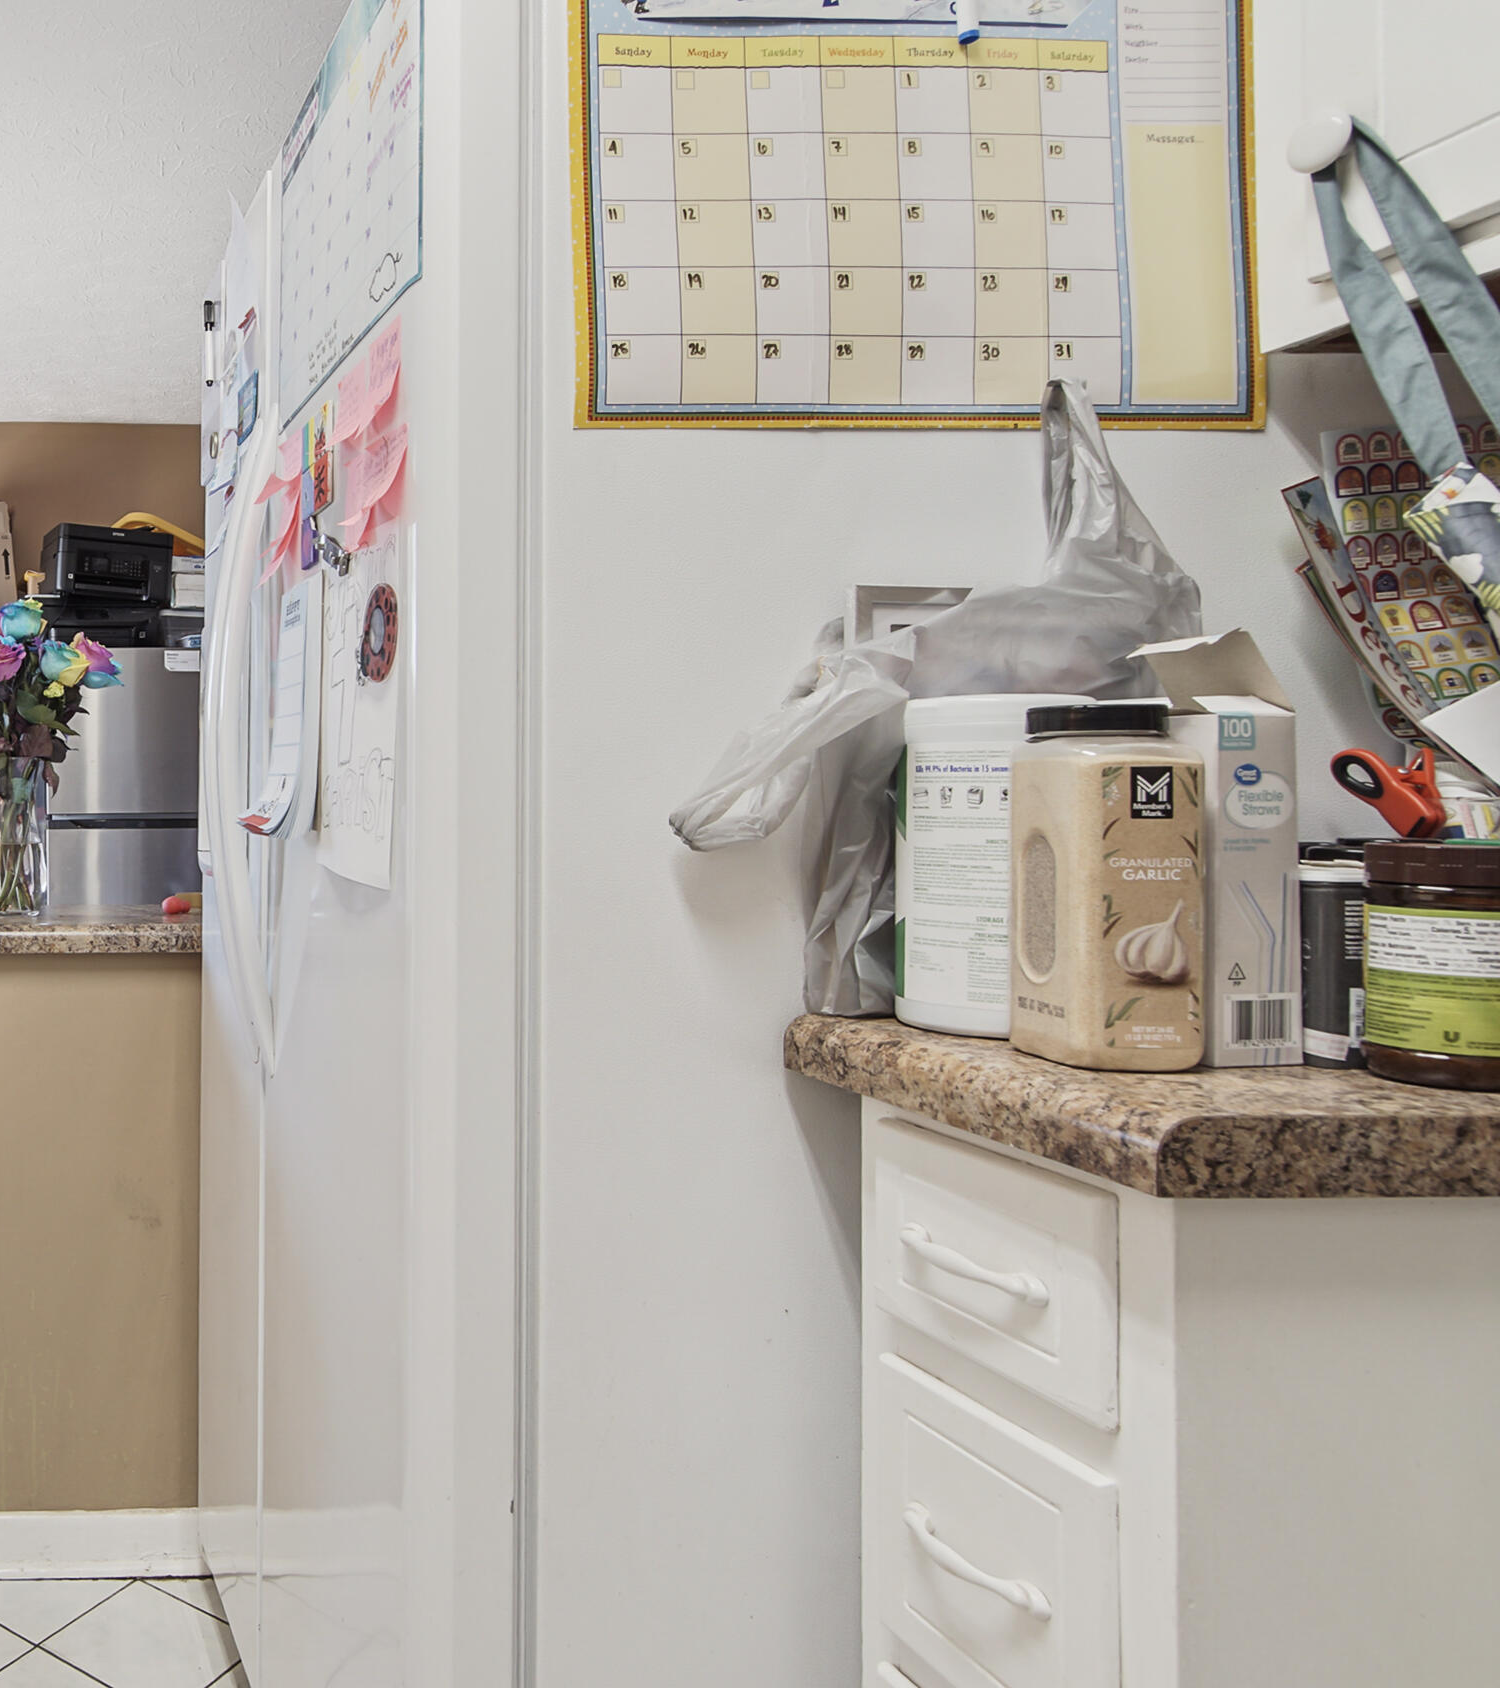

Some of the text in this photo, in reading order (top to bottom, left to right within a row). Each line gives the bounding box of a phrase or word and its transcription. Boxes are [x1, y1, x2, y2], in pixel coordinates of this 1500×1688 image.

[614, 46, 1097, 63] Sunday Monday Tuesday Wednesday Thursday Friday Saturday
[906, 74, 912, 86] 1
[976, 74, 986, 87] 2
[1045, 76, 1054, 90] 3
[608, 140, 617, 155] 4
[681, 142, 691, 155] 5
[758, 142, 768, 154] 6
[831, 141, 842, 153] 7
[908, 141, 917, 154] 8
[980, 142, 990, 153] 9
[1050, 145, 1062, 155] 10
[608, 208, 617, 220] 11
[682, 208, 697, 220] 12
[758, 207, 772, 220] 13
[833, 206, 846, 220] 14
[907, 207, 920, 219] 15
[981, 209, 995, 221] 16
[1051, 208, 1065, 222] 17
[612, 274, 626, 288] 18
[688, 274, 702, 288] 19
[761, 274, 779, 288] 20
[837, 274, 850, 289] 21
[908, 274, 925, 290] 22
[982, 275, 997, 291] 23
[612, 343, 628, 357] 25
[688, 342, 706, 356] 26
[982, 344, 1000, 361] 30
[1054, 344, 1071, 358] 31
[1222, 718, 1252, 738] 100
[950, 765, 972, 773] Bacteria
[982, 765, 989, 773] 15
[1238, 790, 1284, 802] Flexible
[1242, 804, 1281, 816] Straws
[1109, 858, 1192, 868] GRANULATED
[1122, 869, 1181, 880] GARLIC
